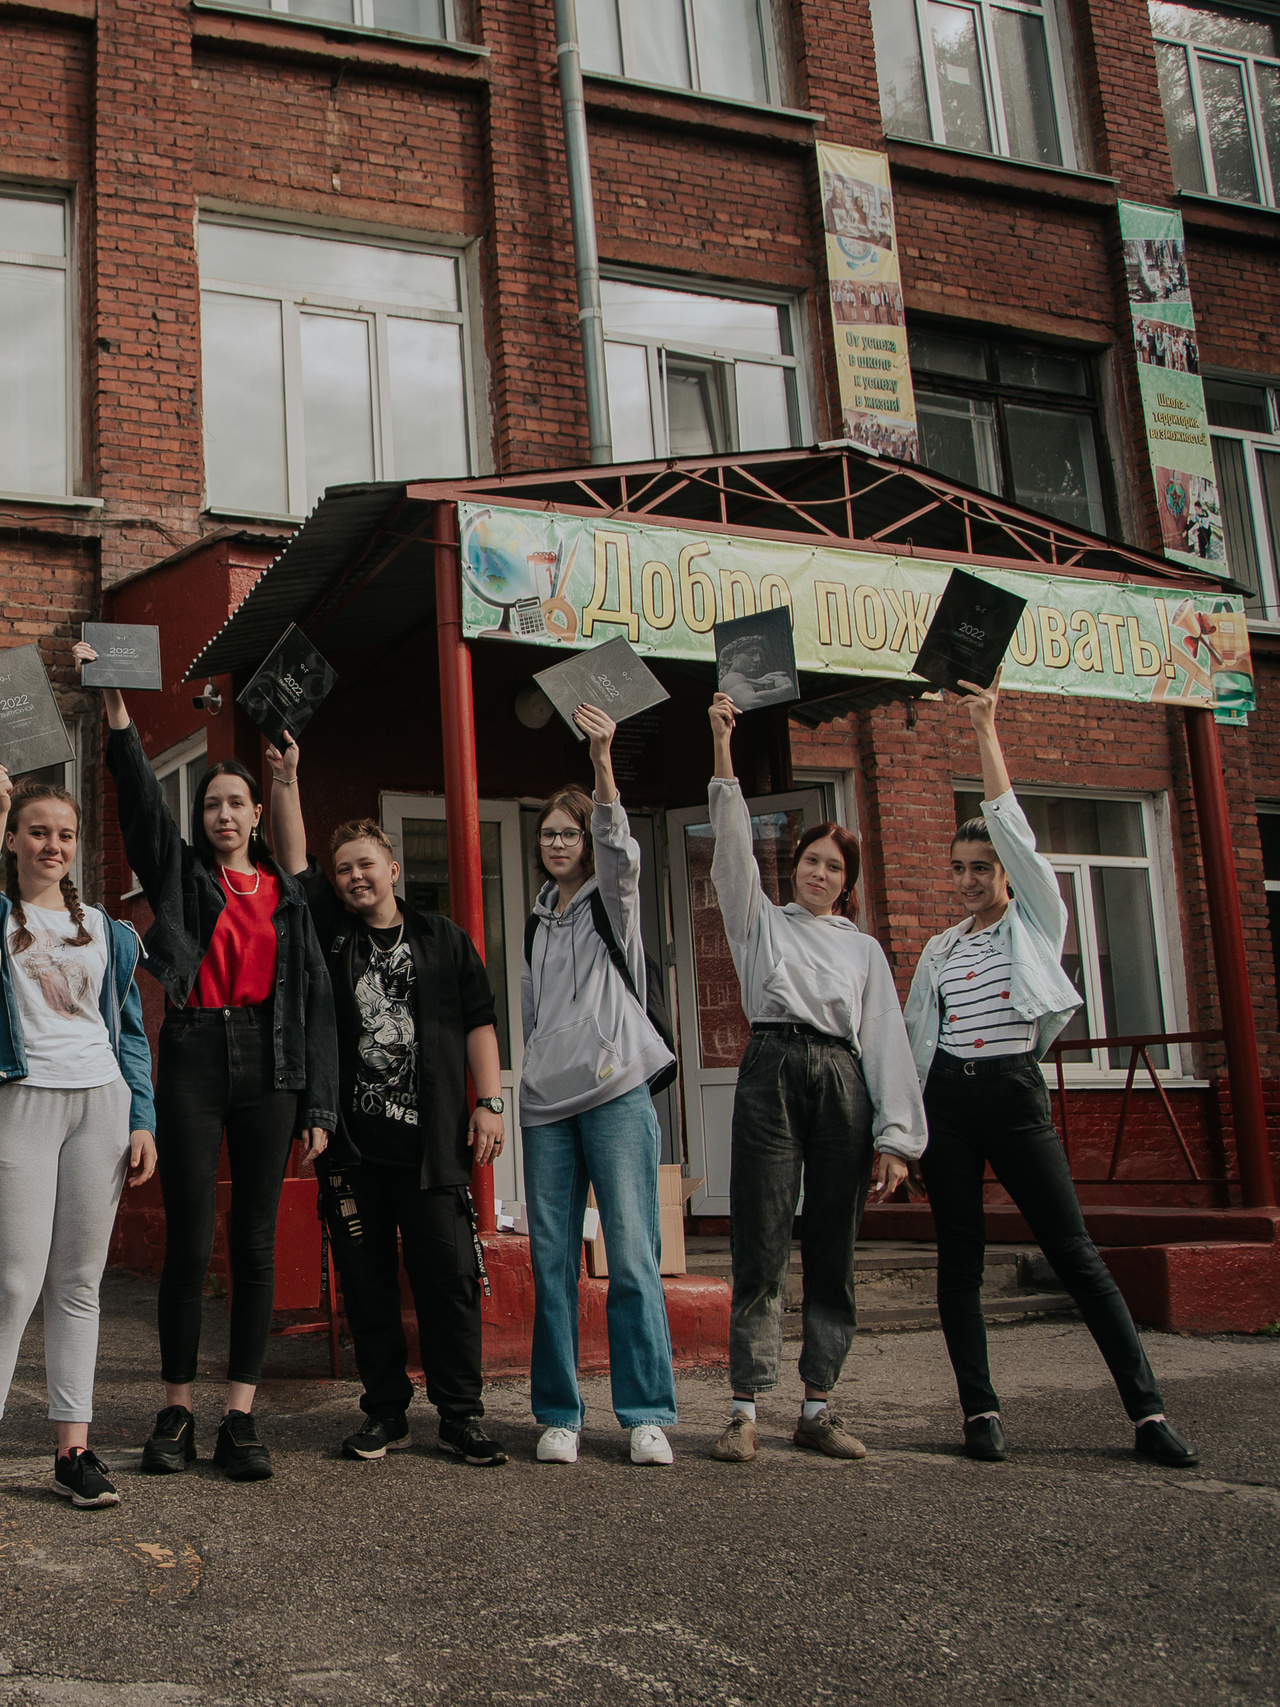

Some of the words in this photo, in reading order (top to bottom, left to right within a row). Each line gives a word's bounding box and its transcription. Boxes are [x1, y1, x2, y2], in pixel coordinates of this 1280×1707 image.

[846, 331, 860, 347] От
[862, 336, 897, 353] успеха
[848, 354, 856, 366] в
[857, 356, 892, 371] школе
[854, 375, 862, 387] к
[862, 376, 898, 394] успеху
[855, 394, 863, 407] в
[864, 395, 900, 412] жизни!
[1157, 393, 1186, 410] Школа
[1152, 411, 1200, 429] территория
[1149, 428, 1207, 446] возможностей
[814, 580, 1176, 680] пожовать!
[958, 622, 986, 640] 2022
[109, 647, 136, 655] 2022
[0, 674, 12, 683] 9-Г
[283, 673, 303, 697] 2022
[597, 673, 620, 698] 2022
[0, 694, 30, 711] 2022
[391, 1091, 418, 1106] not
[385, 1101, 420, 1126] wa
[329, 1176, 342, 1188] TOP
[474, 1244, 486, 1273] SNOW
